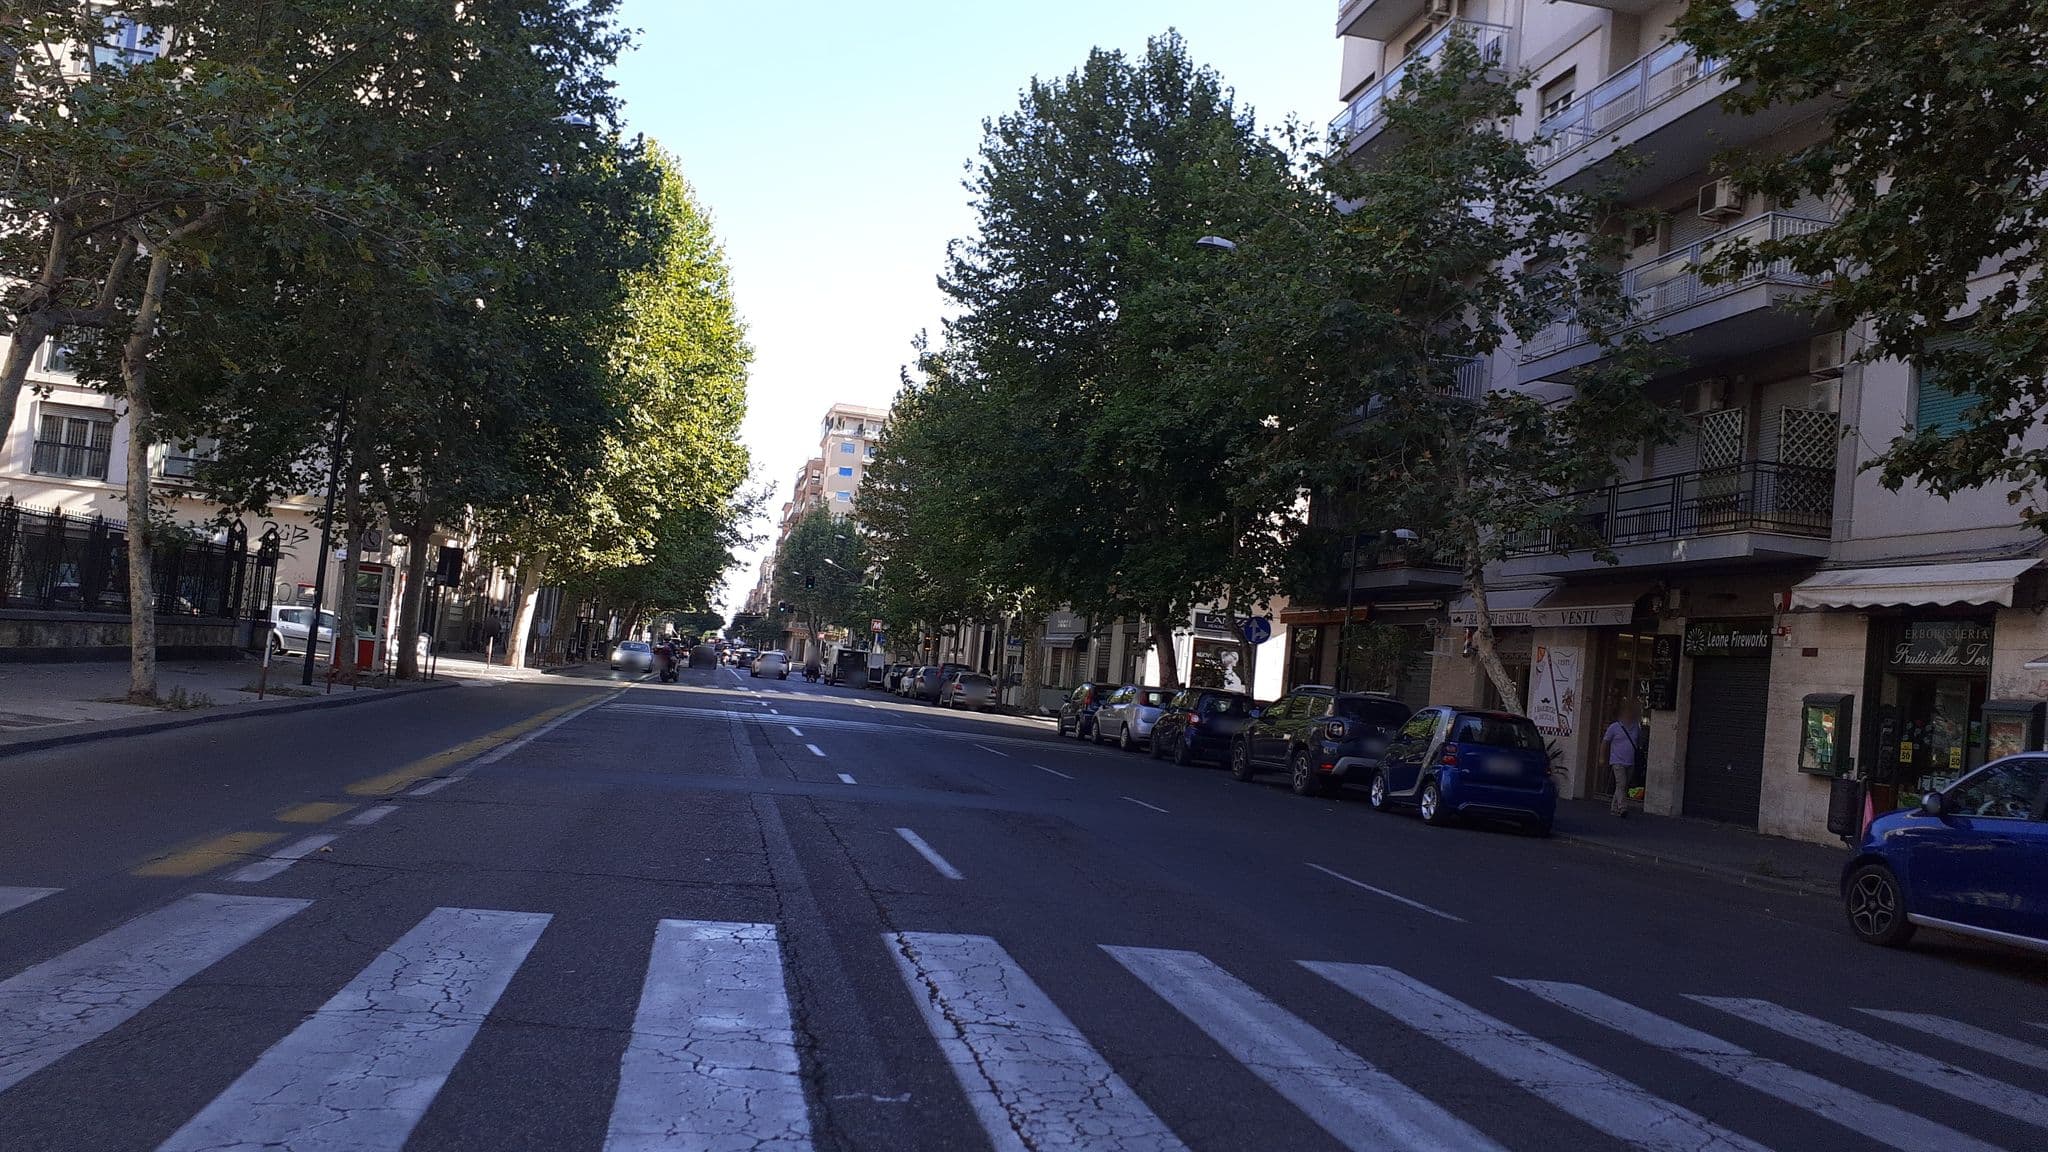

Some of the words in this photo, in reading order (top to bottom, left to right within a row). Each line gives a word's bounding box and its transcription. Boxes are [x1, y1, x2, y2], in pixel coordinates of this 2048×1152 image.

[1707, 632, 1729, 647] Leone
[1731, 630, 1768, 647] Fireworks
[1905, 627, 1989, 640] ERBORISTERIA
[1890, 642, 1928, 665] Frutti
[1929, 645, 1959, 665] della
